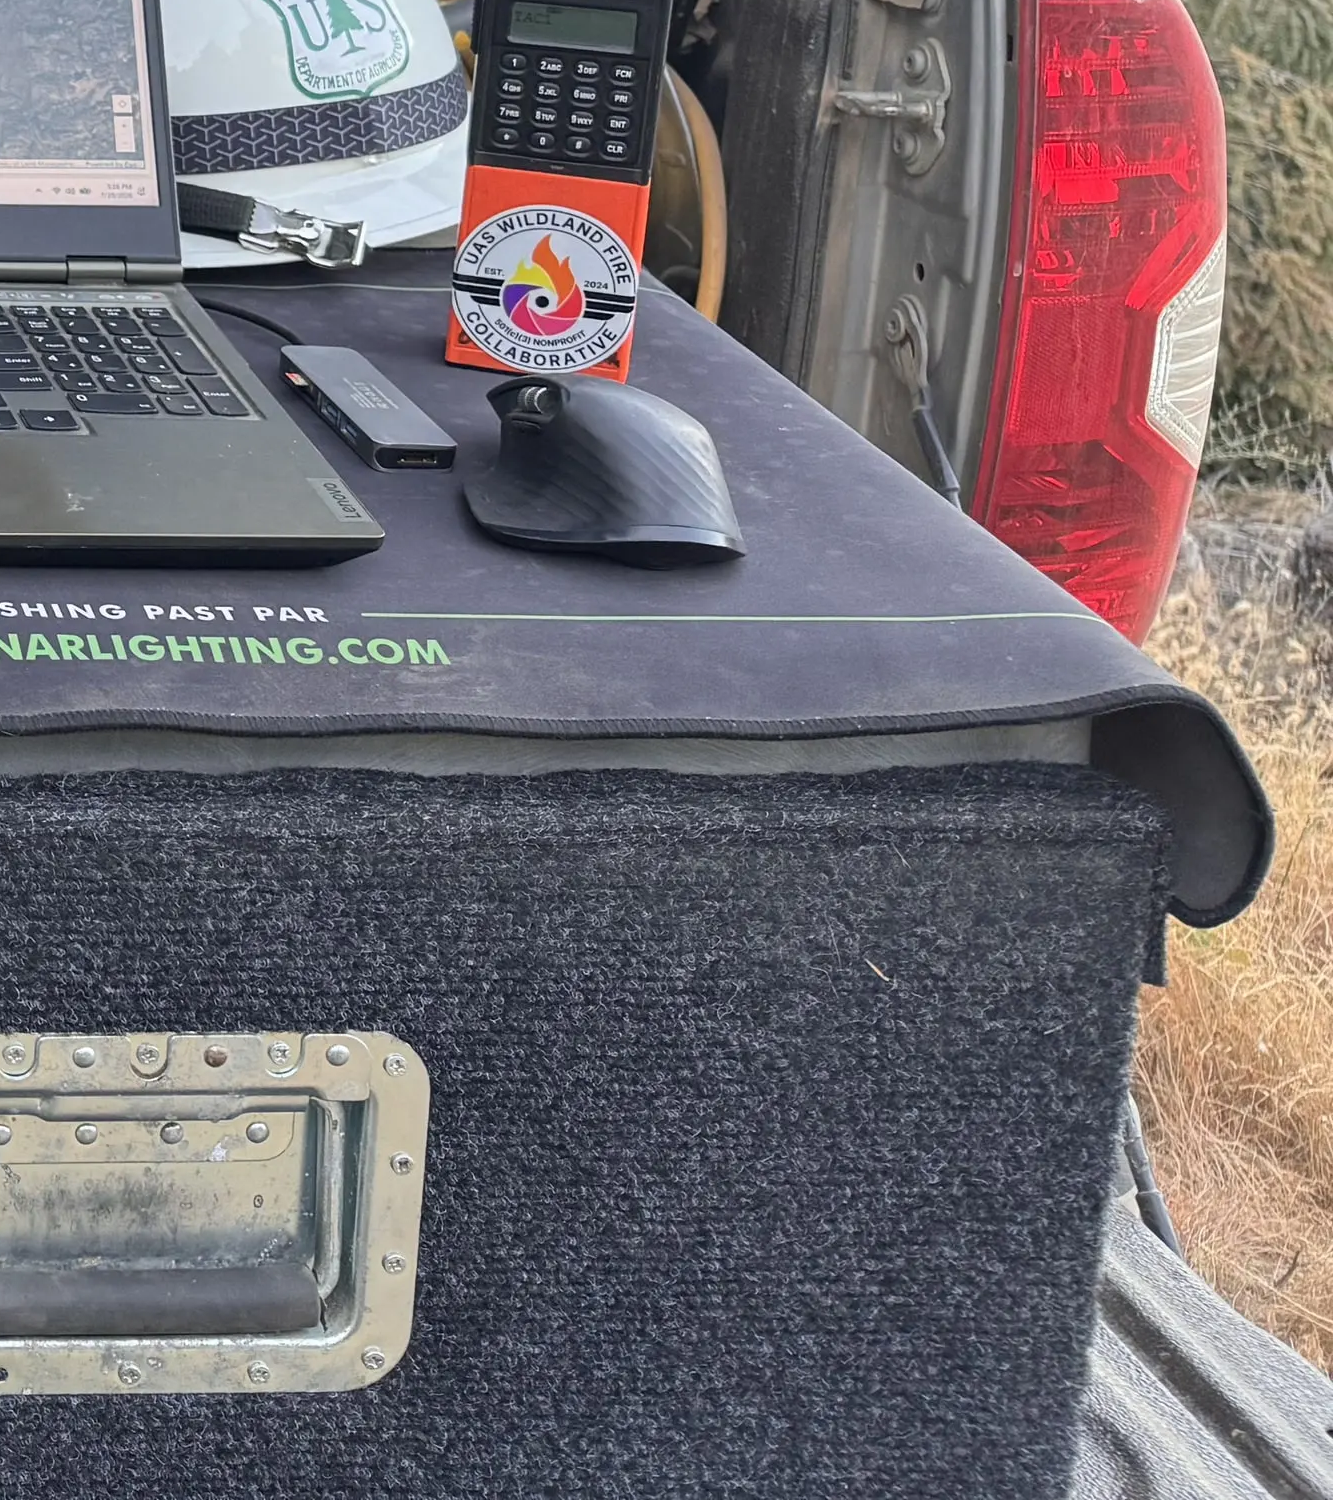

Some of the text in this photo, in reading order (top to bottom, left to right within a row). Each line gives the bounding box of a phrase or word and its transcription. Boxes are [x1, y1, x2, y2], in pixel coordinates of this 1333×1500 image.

[295, 56, 355, 91] DEPARTMENT
[355, 68, 367, 84] OF
[512, 58, 518, 67] 1
[615, 69, 632, 78] FCN
[610, 120, 627, 128] ENT
[539, 136, 546, 146] 0
[607, 145, 624, 154] CLR
[464, 212, 632, 285] UAS WILDLAND FIRE
[484, 267, 505, 276] EST.
[584, 280, 609, 290] 2024
[466, 311, 618, 367] COLLABORATIVE
[533, 330, 587, 347] NONPROFIT
[323, 483, 362, 519] Lenovo
[144, 604, 235, 622] PAST
[254, 605, 329, 623] PAR
